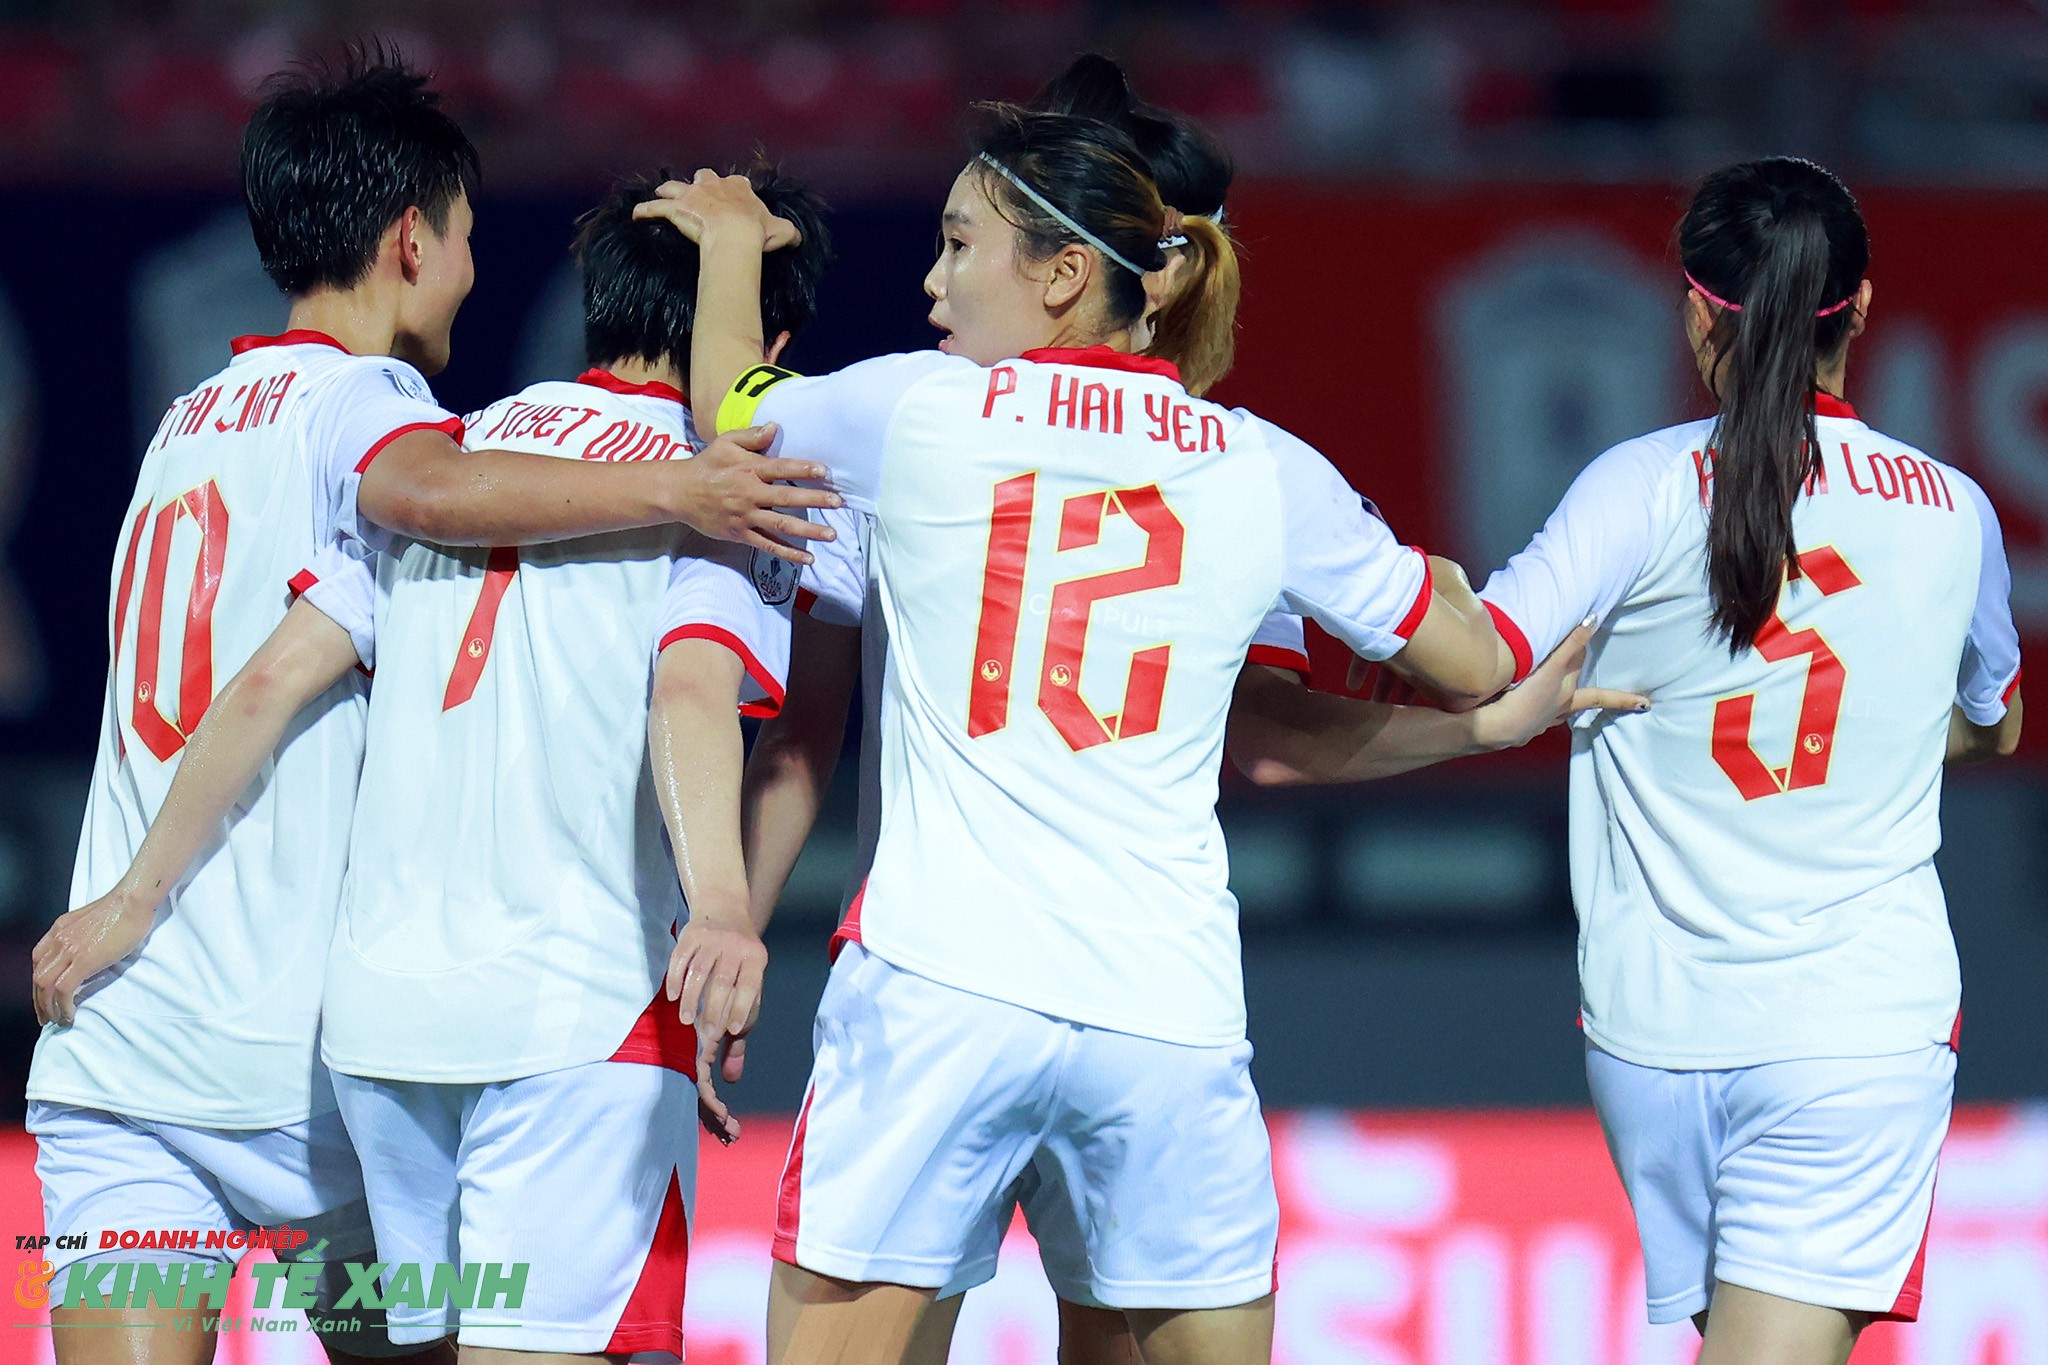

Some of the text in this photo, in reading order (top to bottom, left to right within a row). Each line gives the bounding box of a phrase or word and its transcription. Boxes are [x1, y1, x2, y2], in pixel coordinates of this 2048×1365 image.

[485, 401, 602, 447] TUYET
[982, 366, 1227, 453] P. HAI YEN
[1840, 442, 1955, 512] LOAN
[114, 476, 230, 768] 10
[966, 469, 1187, 754] 12
[1711, 544, 1862, 801] 5
